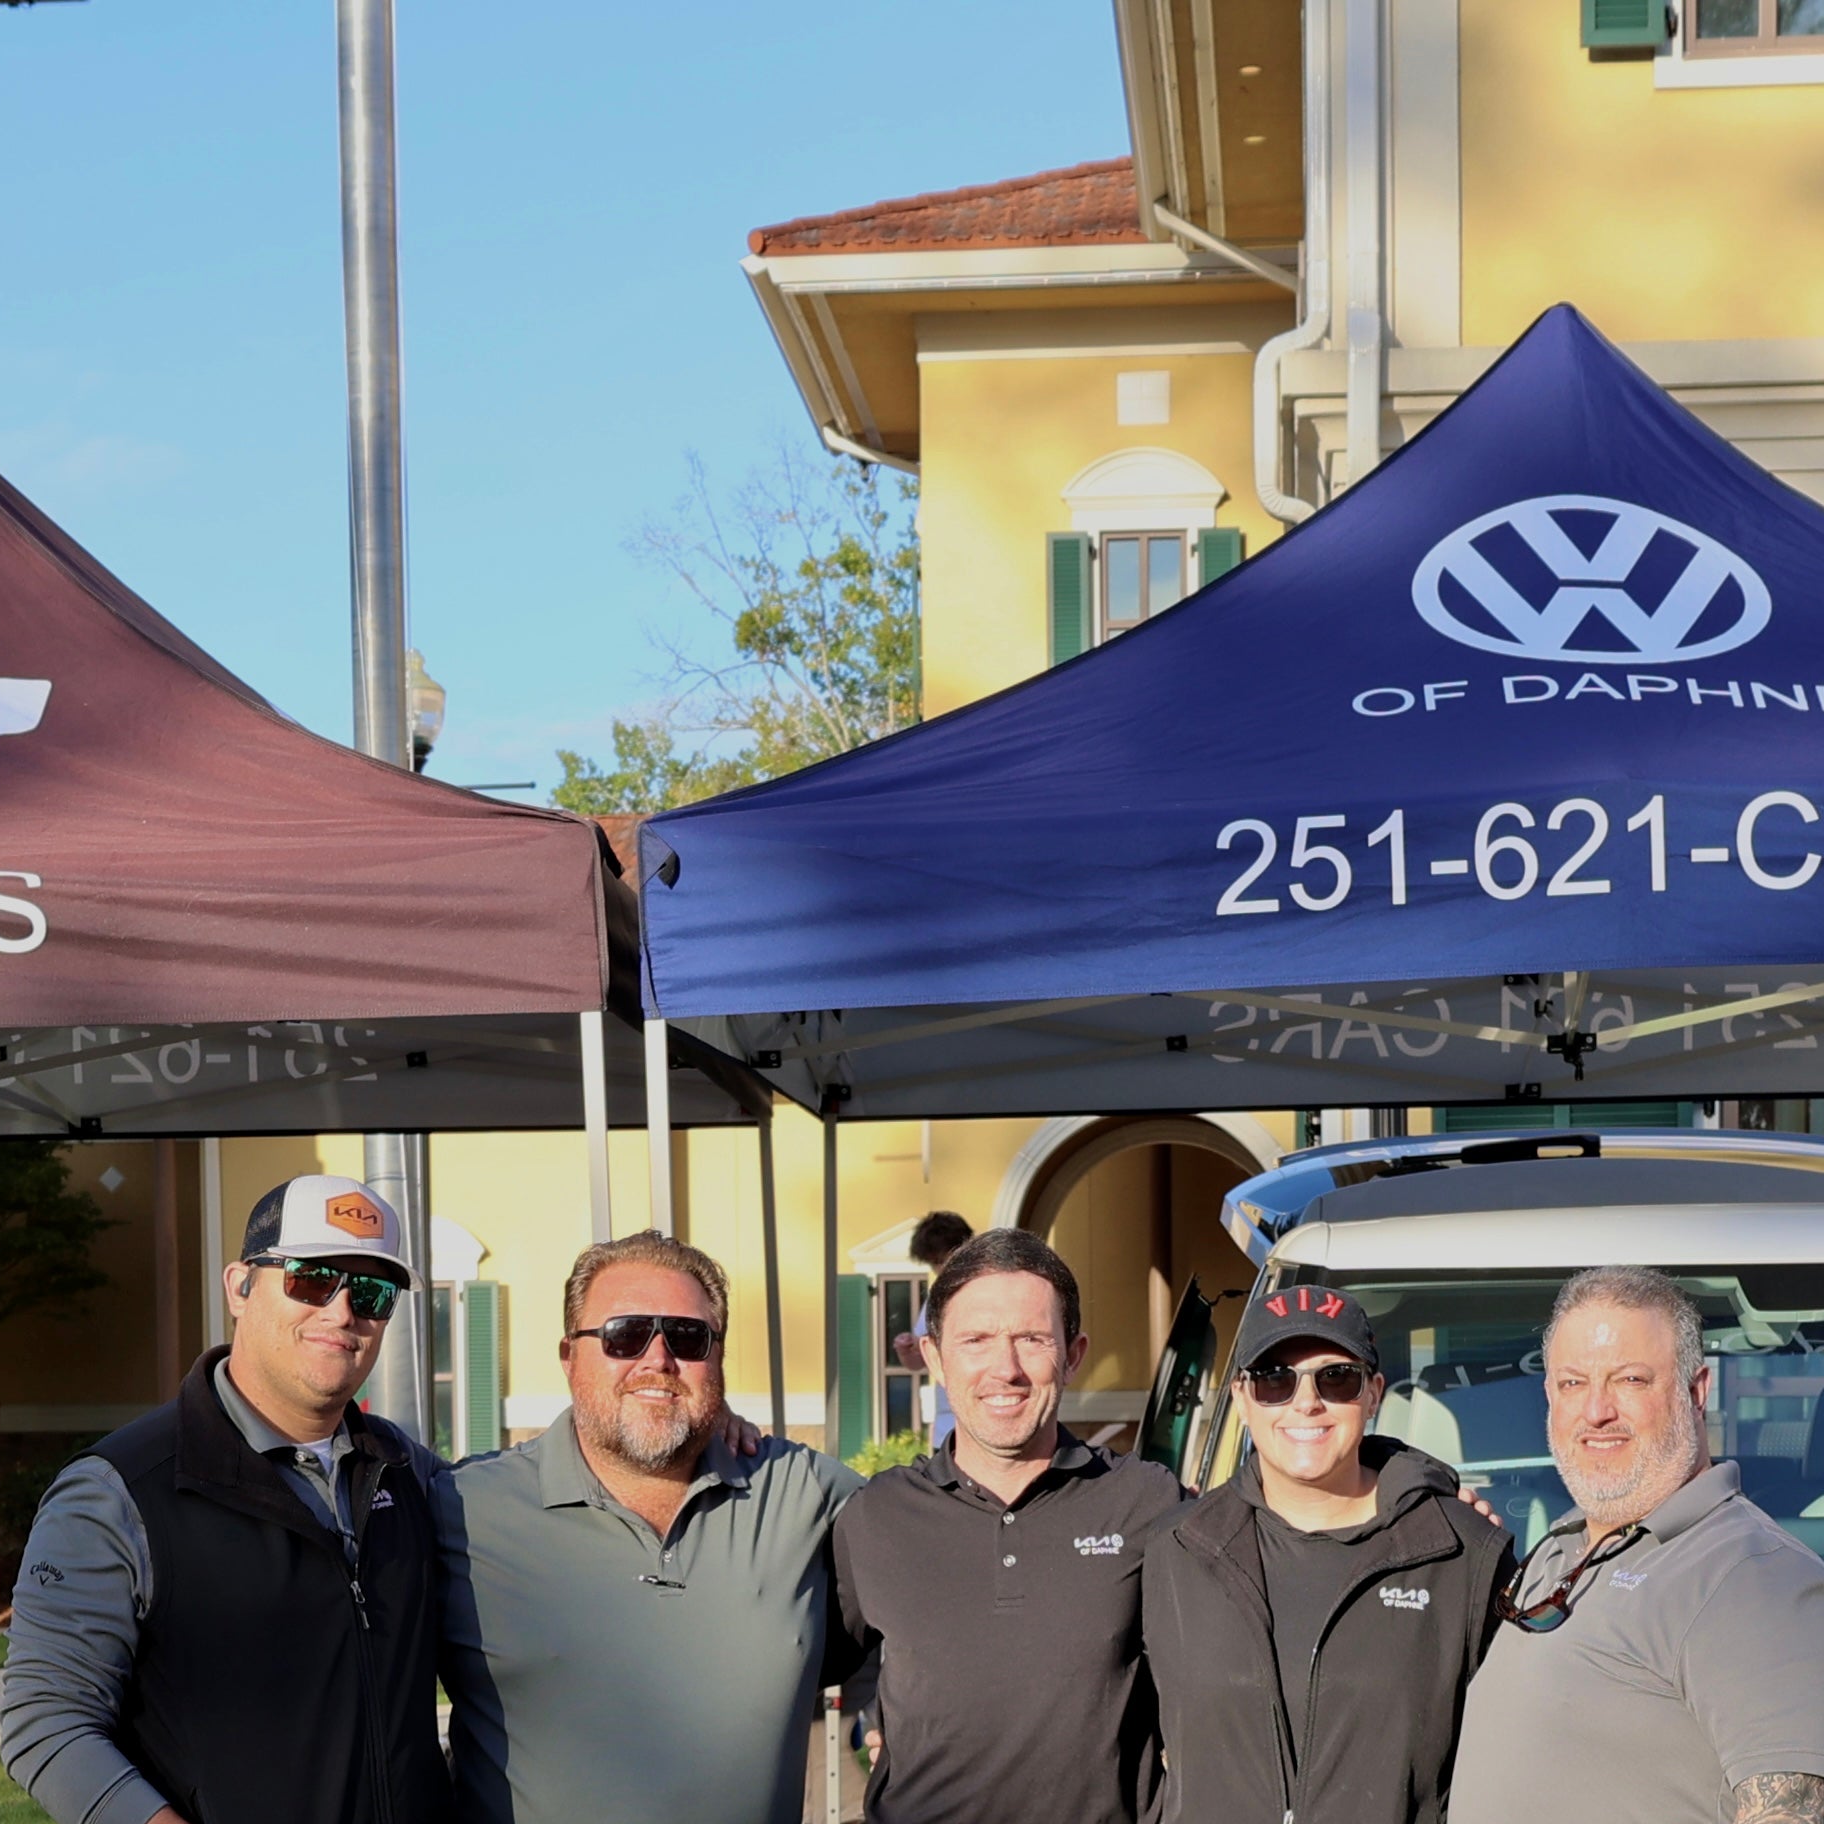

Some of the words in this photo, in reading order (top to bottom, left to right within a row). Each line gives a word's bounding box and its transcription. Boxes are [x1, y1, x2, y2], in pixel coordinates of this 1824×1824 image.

[1352, 680, 1468, 717] OF
[333, 1206, 378, 1225] KIA
[1265, 1287, 1345, 1319] KIA
